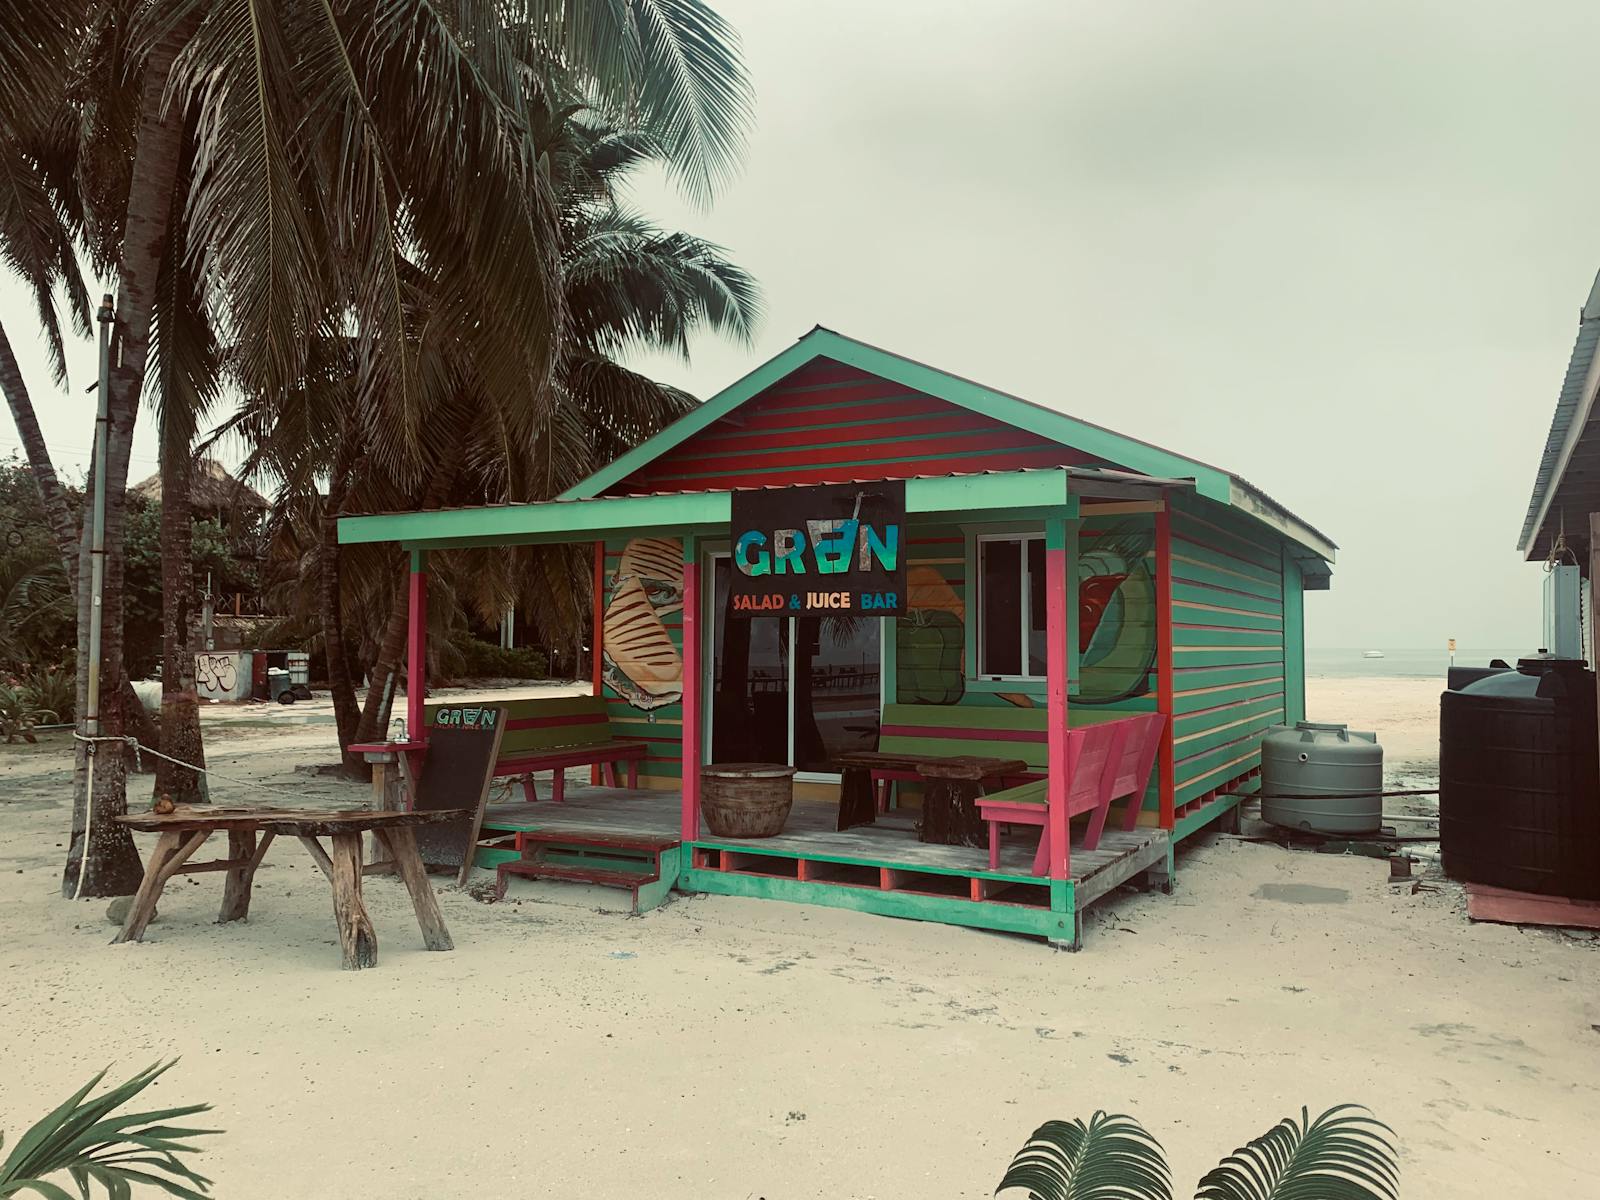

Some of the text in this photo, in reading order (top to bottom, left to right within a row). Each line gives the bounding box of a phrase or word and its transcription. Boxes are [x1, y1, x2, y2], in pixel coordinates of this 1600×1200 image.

[733, 592, 897, 610] SALAD & JUICE BAR
